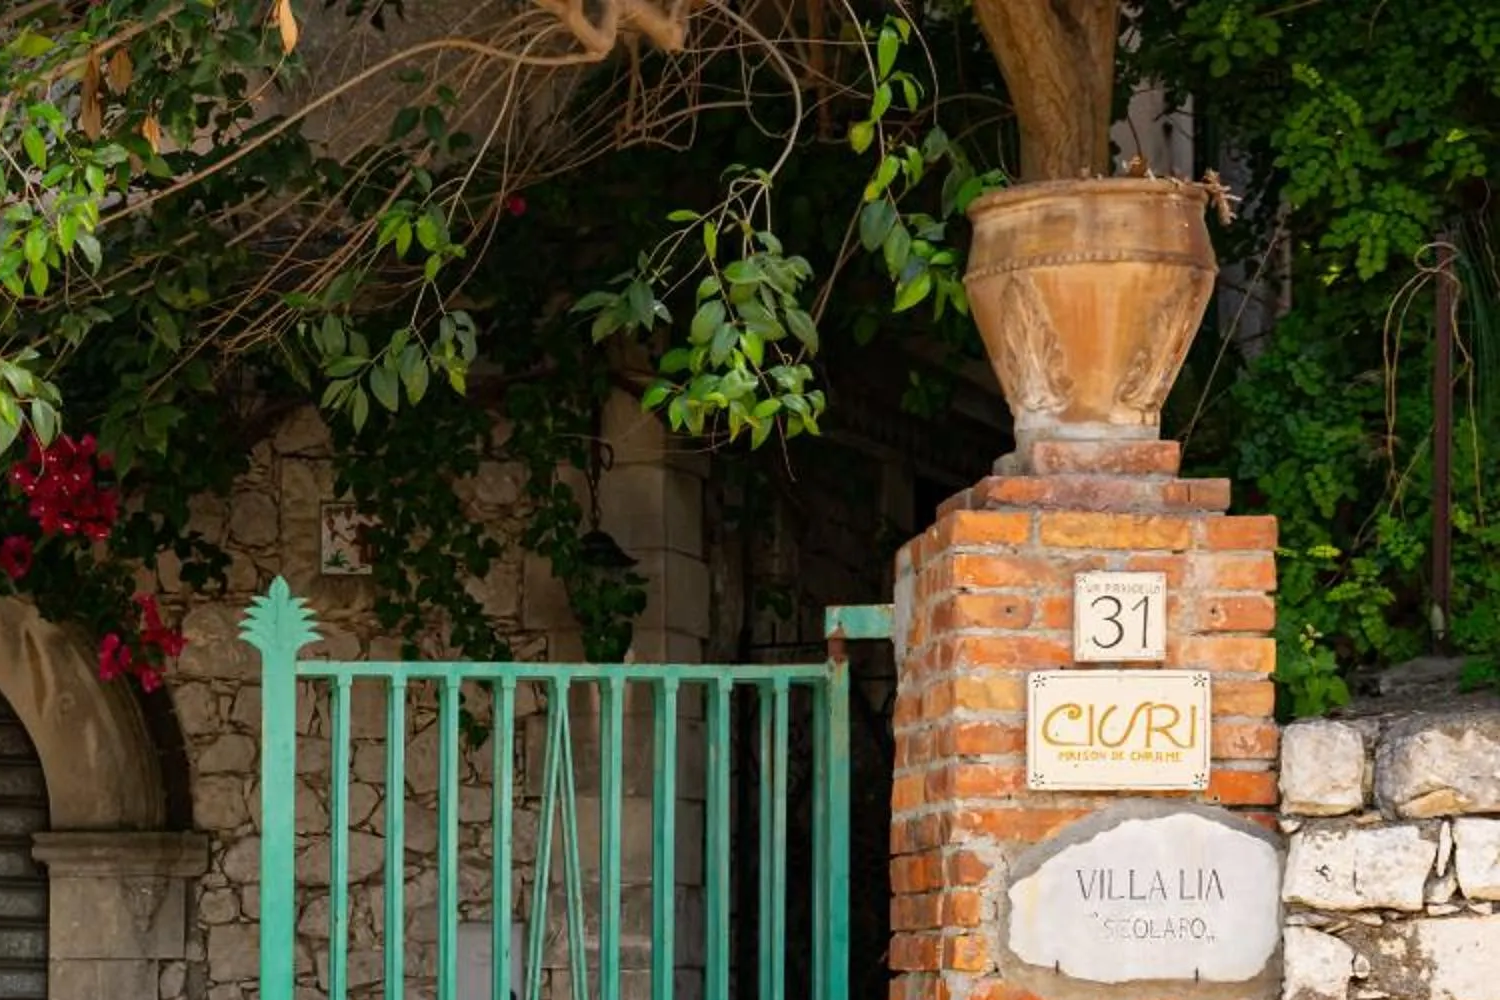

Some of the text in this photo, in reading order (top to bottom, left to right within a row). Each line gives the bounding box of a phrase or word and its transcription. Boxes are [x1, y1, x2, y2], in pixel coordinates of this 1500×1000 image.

[1090, 594, 1150, 649] 31
[1042, 701, 1196, 748] CIURI
[1076, 868, 1224, 900] VILLA LIA
